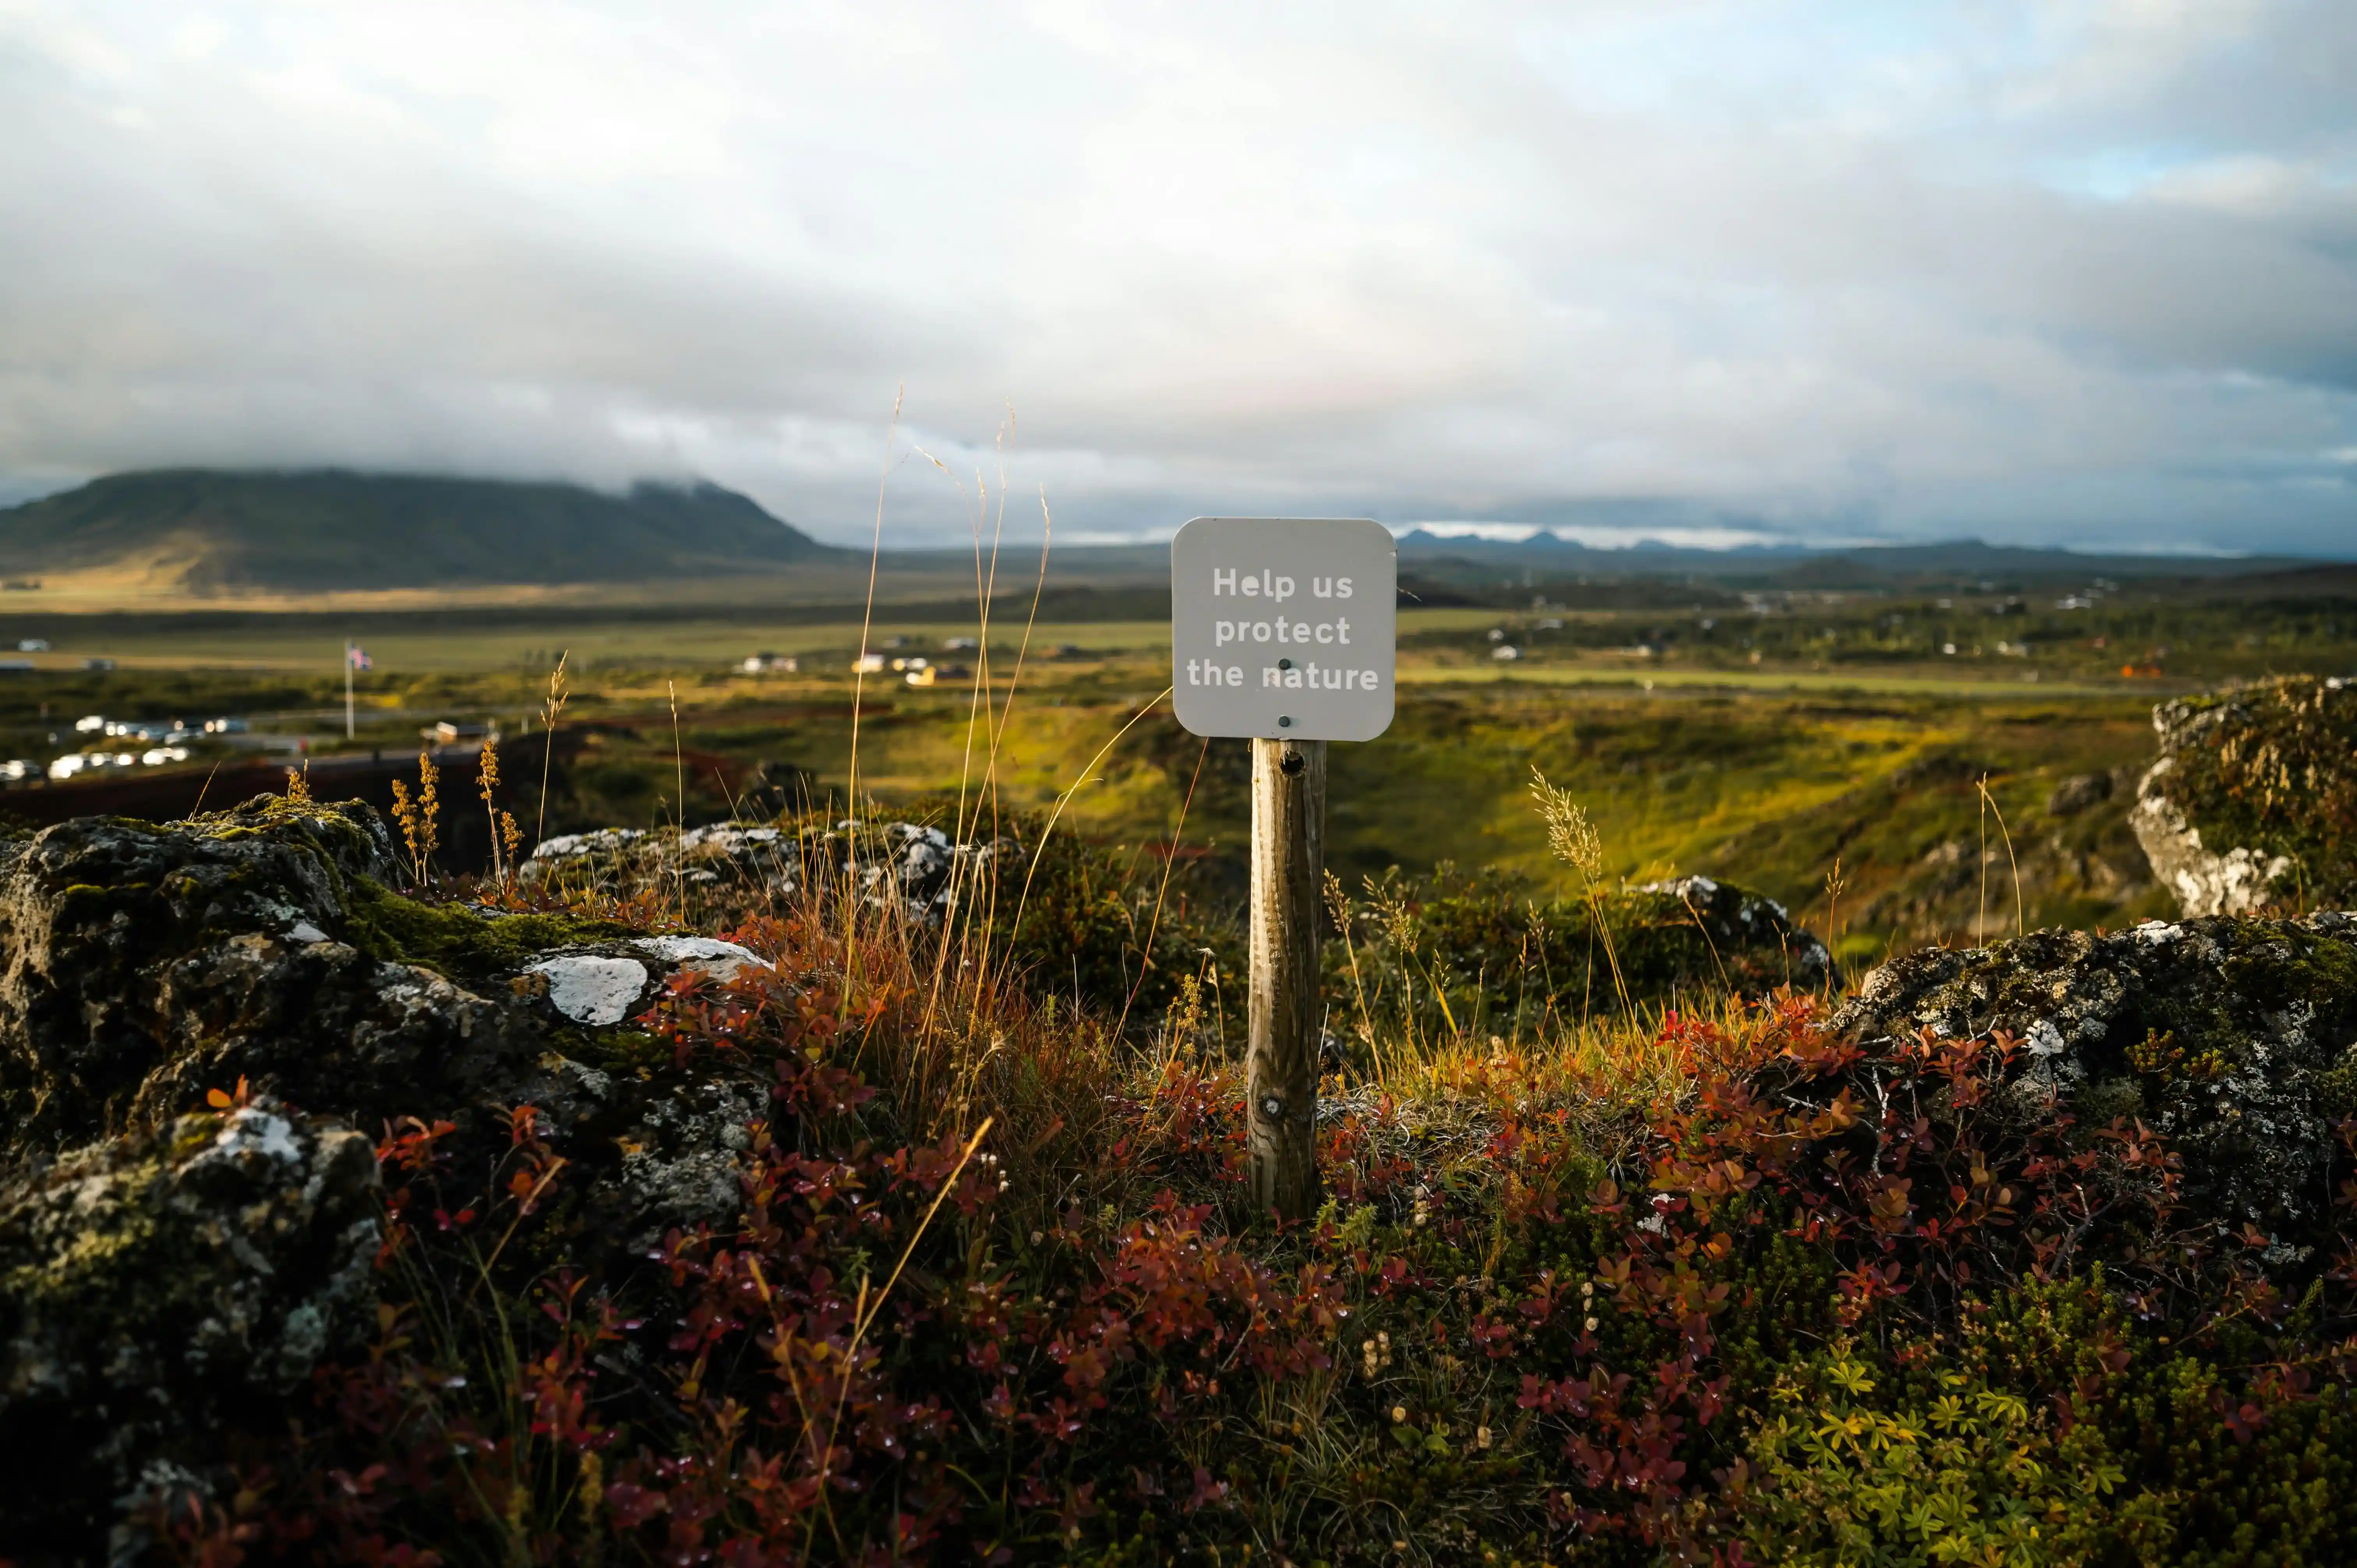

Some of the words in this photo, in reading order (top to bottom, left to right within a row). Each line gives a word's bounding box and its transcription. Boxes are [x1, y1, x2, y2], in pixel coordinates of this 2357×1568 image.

[1214, 568, 1295, 602] Help
[1313, 577, 1353, 598] us
[1216, 616, 1350, 646] protect
[1187, 659, 1244, 687] the
[1262, 662, 1378, 690] nature
